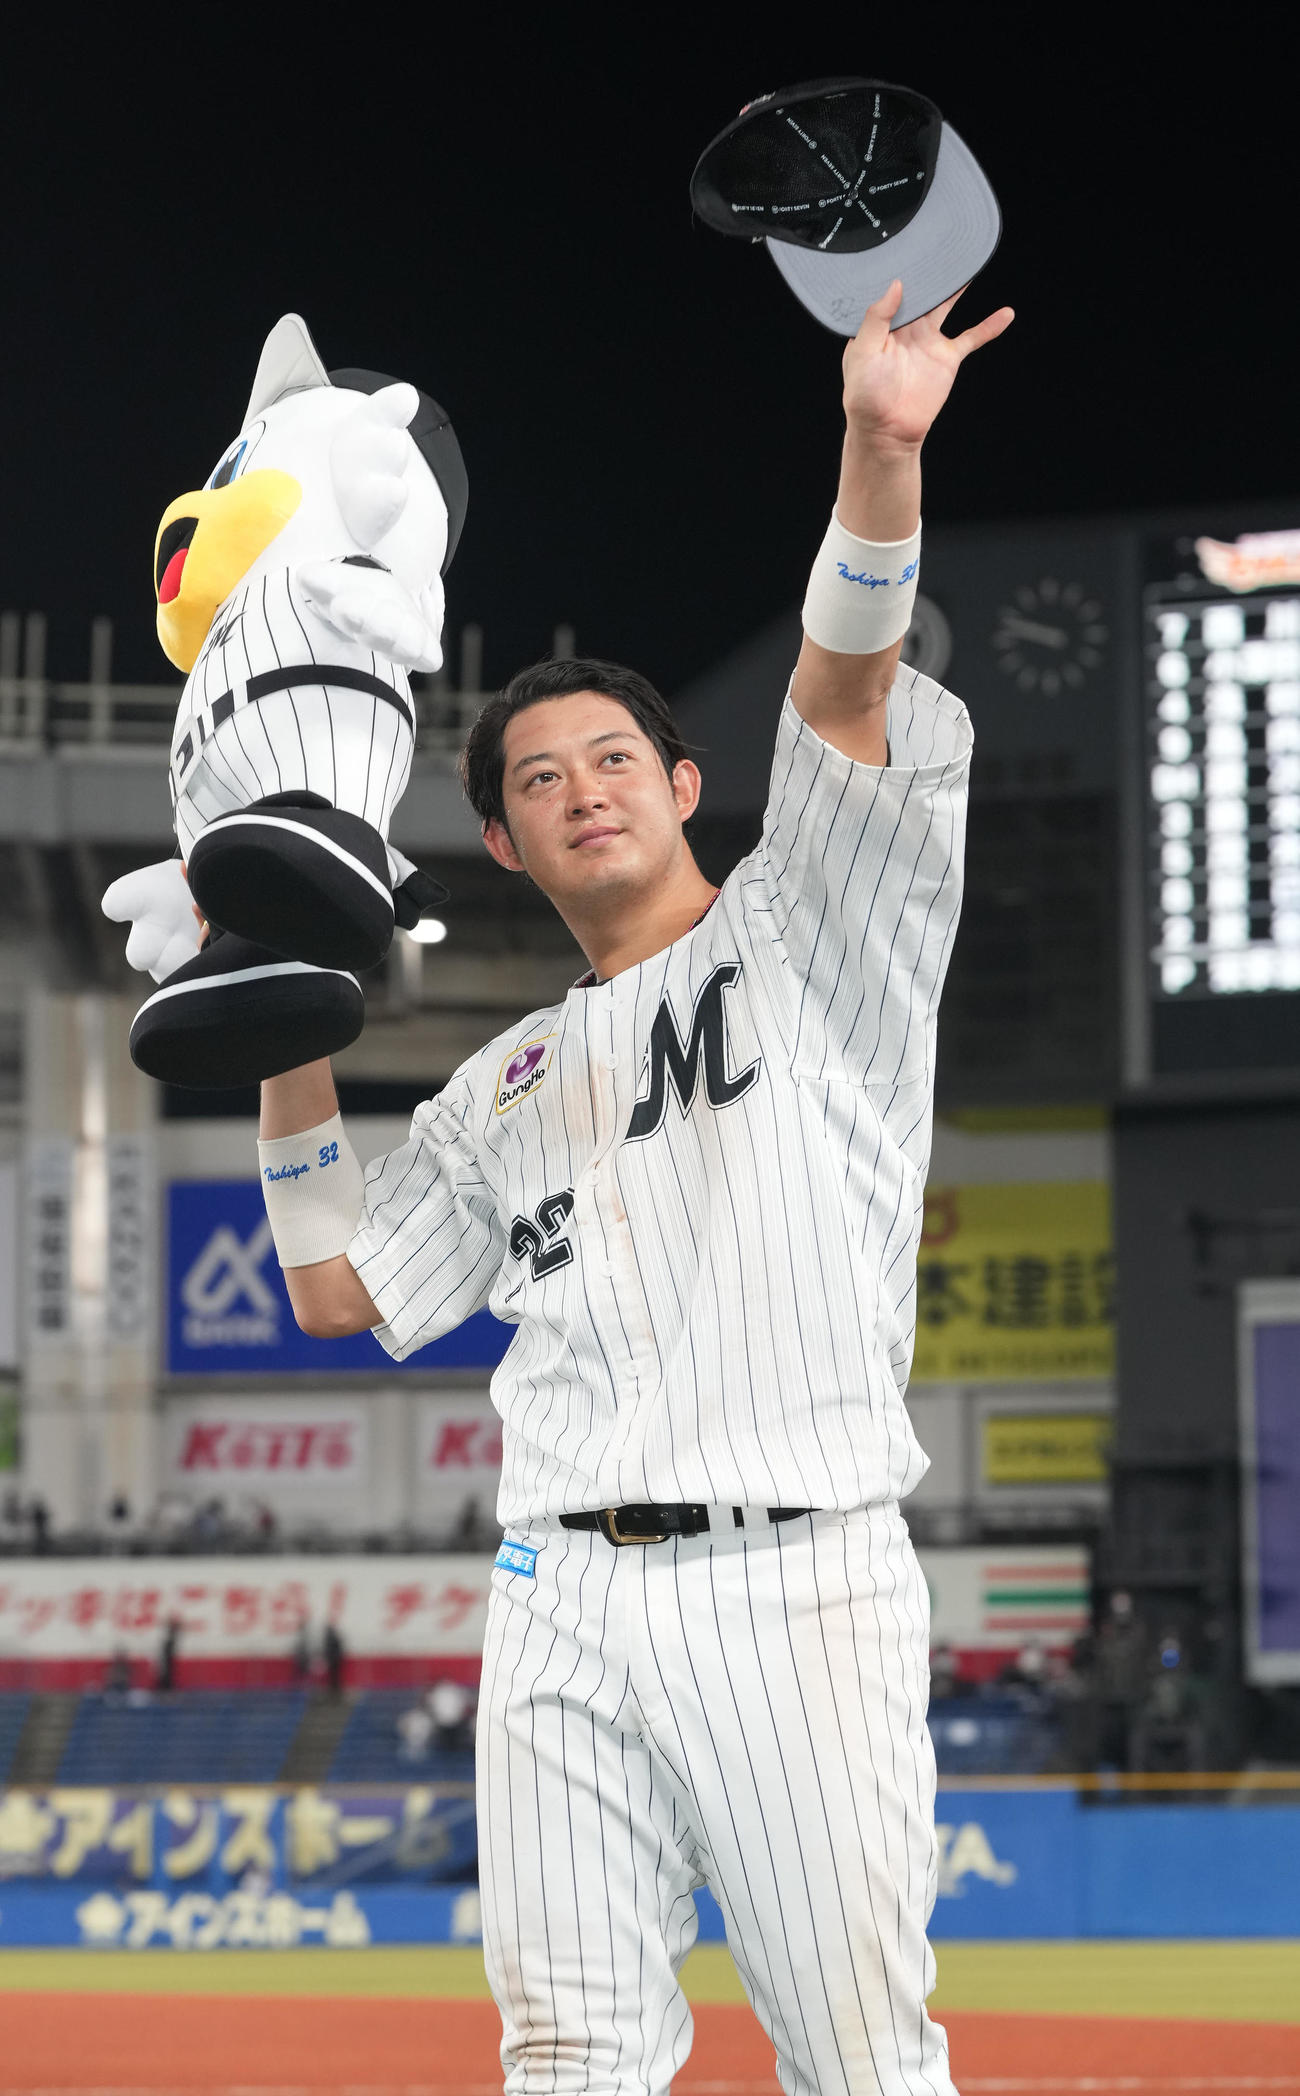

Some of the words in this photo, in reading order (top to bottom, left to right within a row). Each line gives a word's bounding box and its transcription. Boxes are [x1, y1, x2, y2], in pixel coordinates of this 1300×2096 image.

[820, 153, 835, 170] SEVEN
[832, 169, 846, 184] FORTY
[877, 183, 893, 191] FORTY
[893, 177, 908, 187] SEVEN
[793, 203, 810, 211] SEVEN
[864, 208, 876, 222] FORTY
[499, 1068, 546, 1107] GungHo
[318, 1141, 339, 1168] 32
